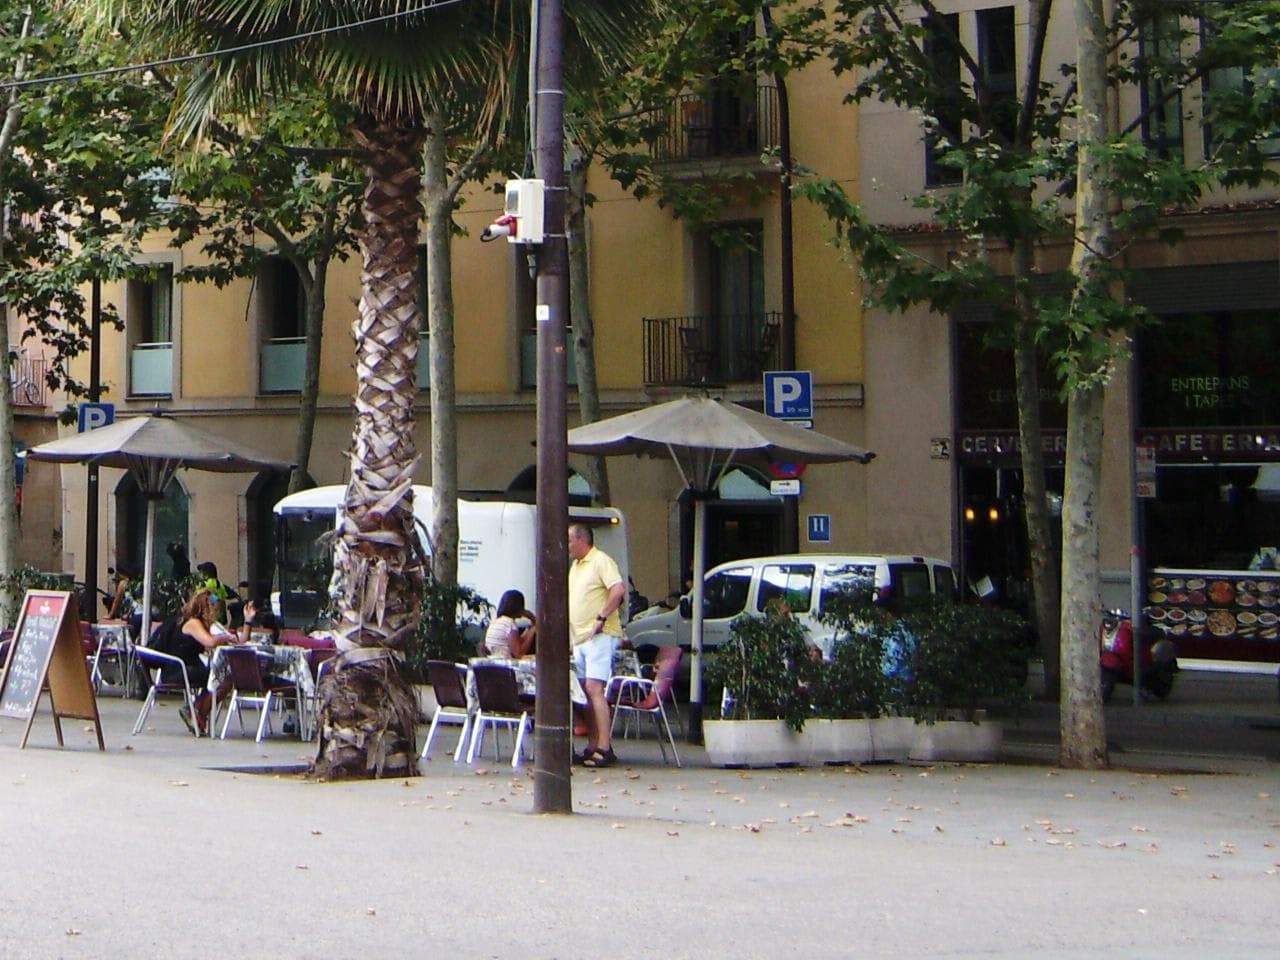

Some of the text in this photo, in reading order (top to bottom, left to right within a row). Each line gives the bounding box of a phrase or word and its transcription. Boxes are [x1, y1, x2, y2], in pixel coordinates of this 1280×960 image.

[1171, 376, 1249, 392] ENTREPNS
[773, 376, 802, 414] P
[1192, 394, 1236, 408] TAP
[84, 407, 106, 432] P
[1142, 433, 1280, 452] CAFETERA
